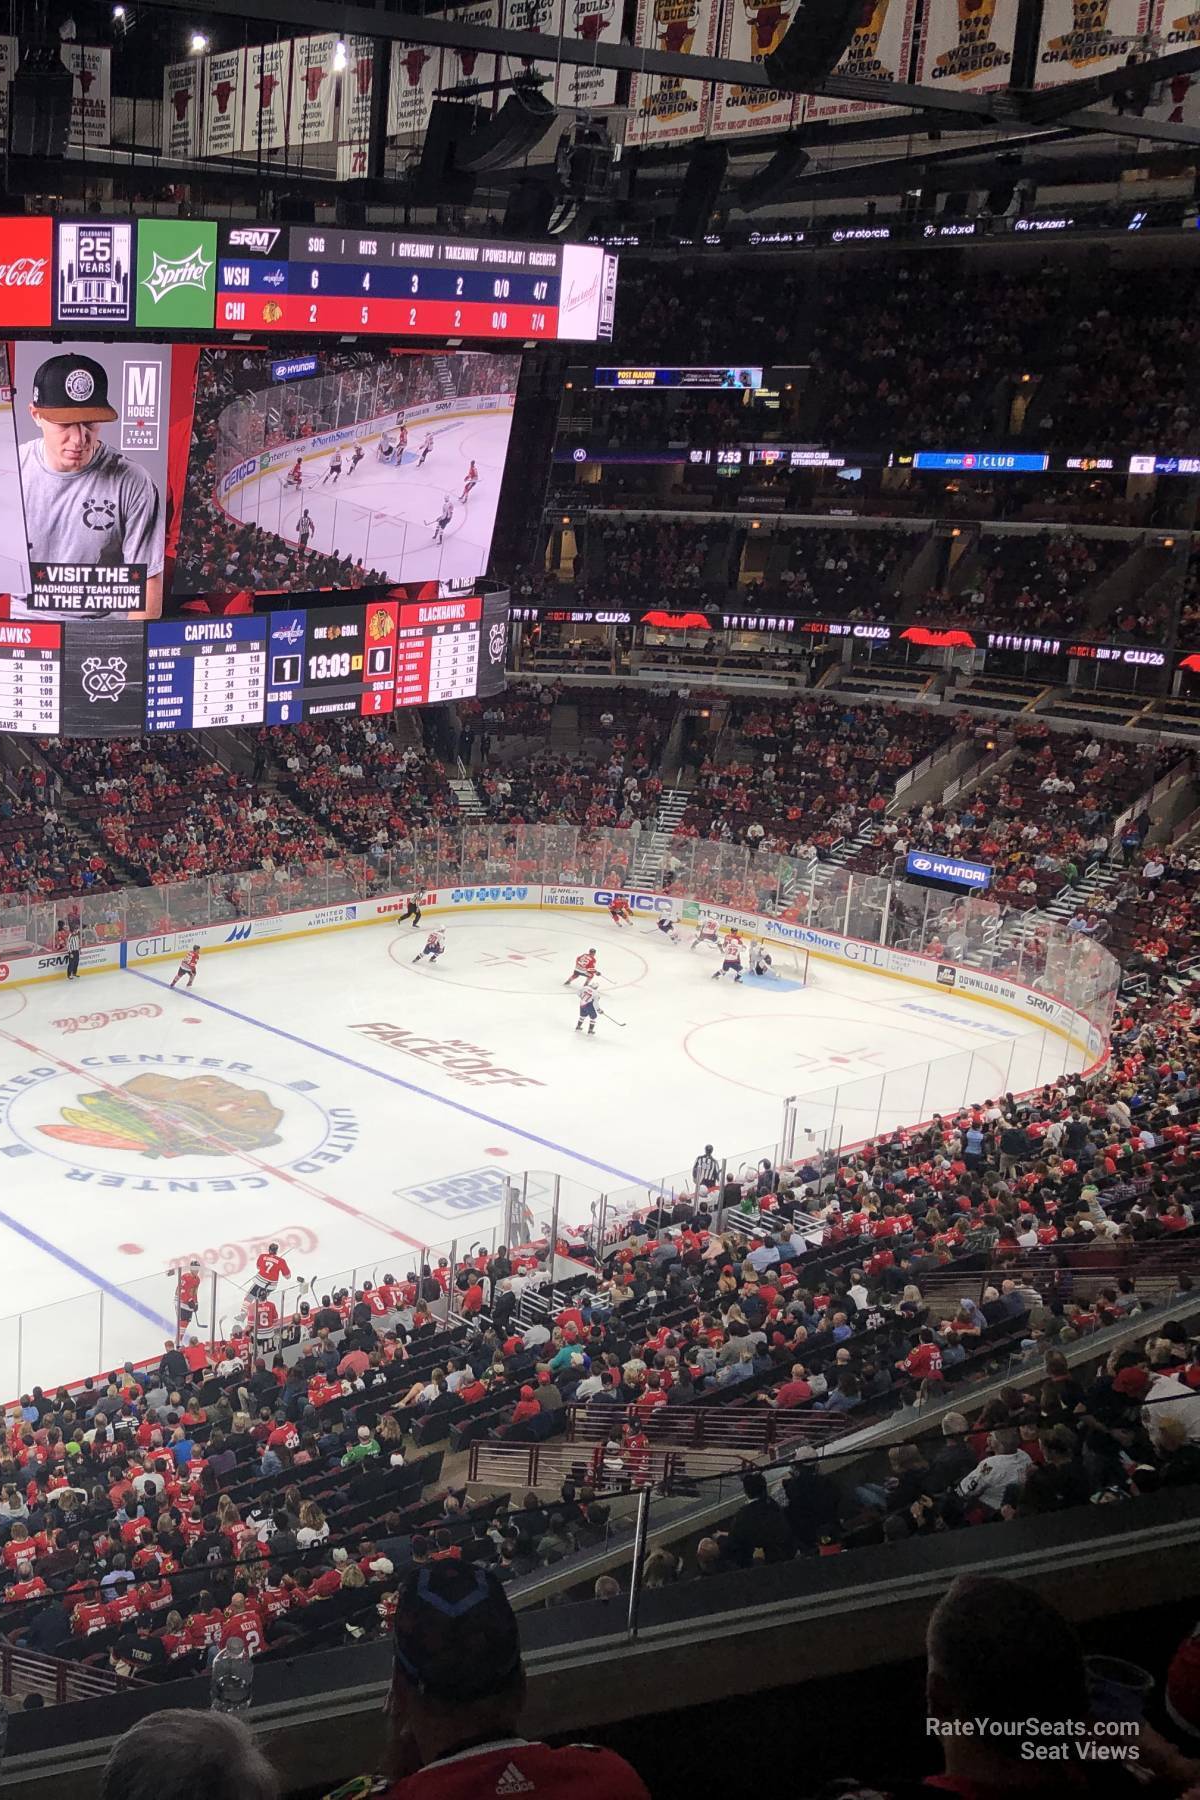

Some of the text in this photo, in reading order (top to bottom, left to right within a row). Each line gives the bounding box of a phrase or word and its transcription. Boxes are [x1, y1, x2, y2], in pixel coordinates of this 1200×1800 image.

[931, 52, 1011, 80] CHAMPIONS
[229, 230, 270, 247] SRM
[79, 238, 111, 262] 25
[308, 237, 557, 267] SOG HITS GIVEAWAY TAKEAWAY FACEOFFS
[79, 262, 111, 274] YEARS
[151, 261, 204, 289] Sprite
[223, 266, 548, 301] WSH 4/7
[225, 302, 246, 321] CHI
[287, 361, 316, 375] HYUNDAI
[127, 366, 157, 407] M
[127, 406, 156, 418] HOUSE
[126, 437, 154, 445] STORE
[717, 451, 742, 464] 7:53
[983, 456, 1015, 468] CLUB
[46, 566, 129, 583] VISIT THE
[34, 584, 140, 595] MADHOUSE TEAM STORE
[34, 594, 140, 609] IN THE ATRIUM
[418, 603, 465, 623] BLACKHAWKS
[184, 622, 233, 641] CAPITALS
[314, 624, 359, 640] ONE GOAL
[722, 616, 795, 632] BATWOMAN
[158, 647, 170, 657] THE
[308, 652, 350, 680] 13:03
[0, 721, 18, 730] SAVES
[932, 862, 986, 882] HYUNDAI
[544, 894, 585, 906] LIVE GAMES
[307, 915, 343, 928] AIRLINES
[314, 908, 344, 920] UNITED
[773, 921, 841, 951] NorthShore
[135, 936, 172, 957] GTL
[844, 942, 884, 968] GTL
[958, 975, 1016, 1000] DOWNLOAD NOW
[1026, 993, 1055, 1015] SRM
[346, 1022, 549, 1088] FACE-OFF
[442, 1039, 497, 1058] NHL
[80, 1054, 254, 1073] CENTER
[63, 1107, 360, 1194] UNITED CENTER
[264, 1261, 274, 1274] 7
[371, 1295, 382, 1310] 8
[259, 1313, 269, 1326] 6
[240, 1621, 258, 1632] KEITH
[245, 1630, 260, 1656] 2
[495, 1778, 535, 1795] adidas
